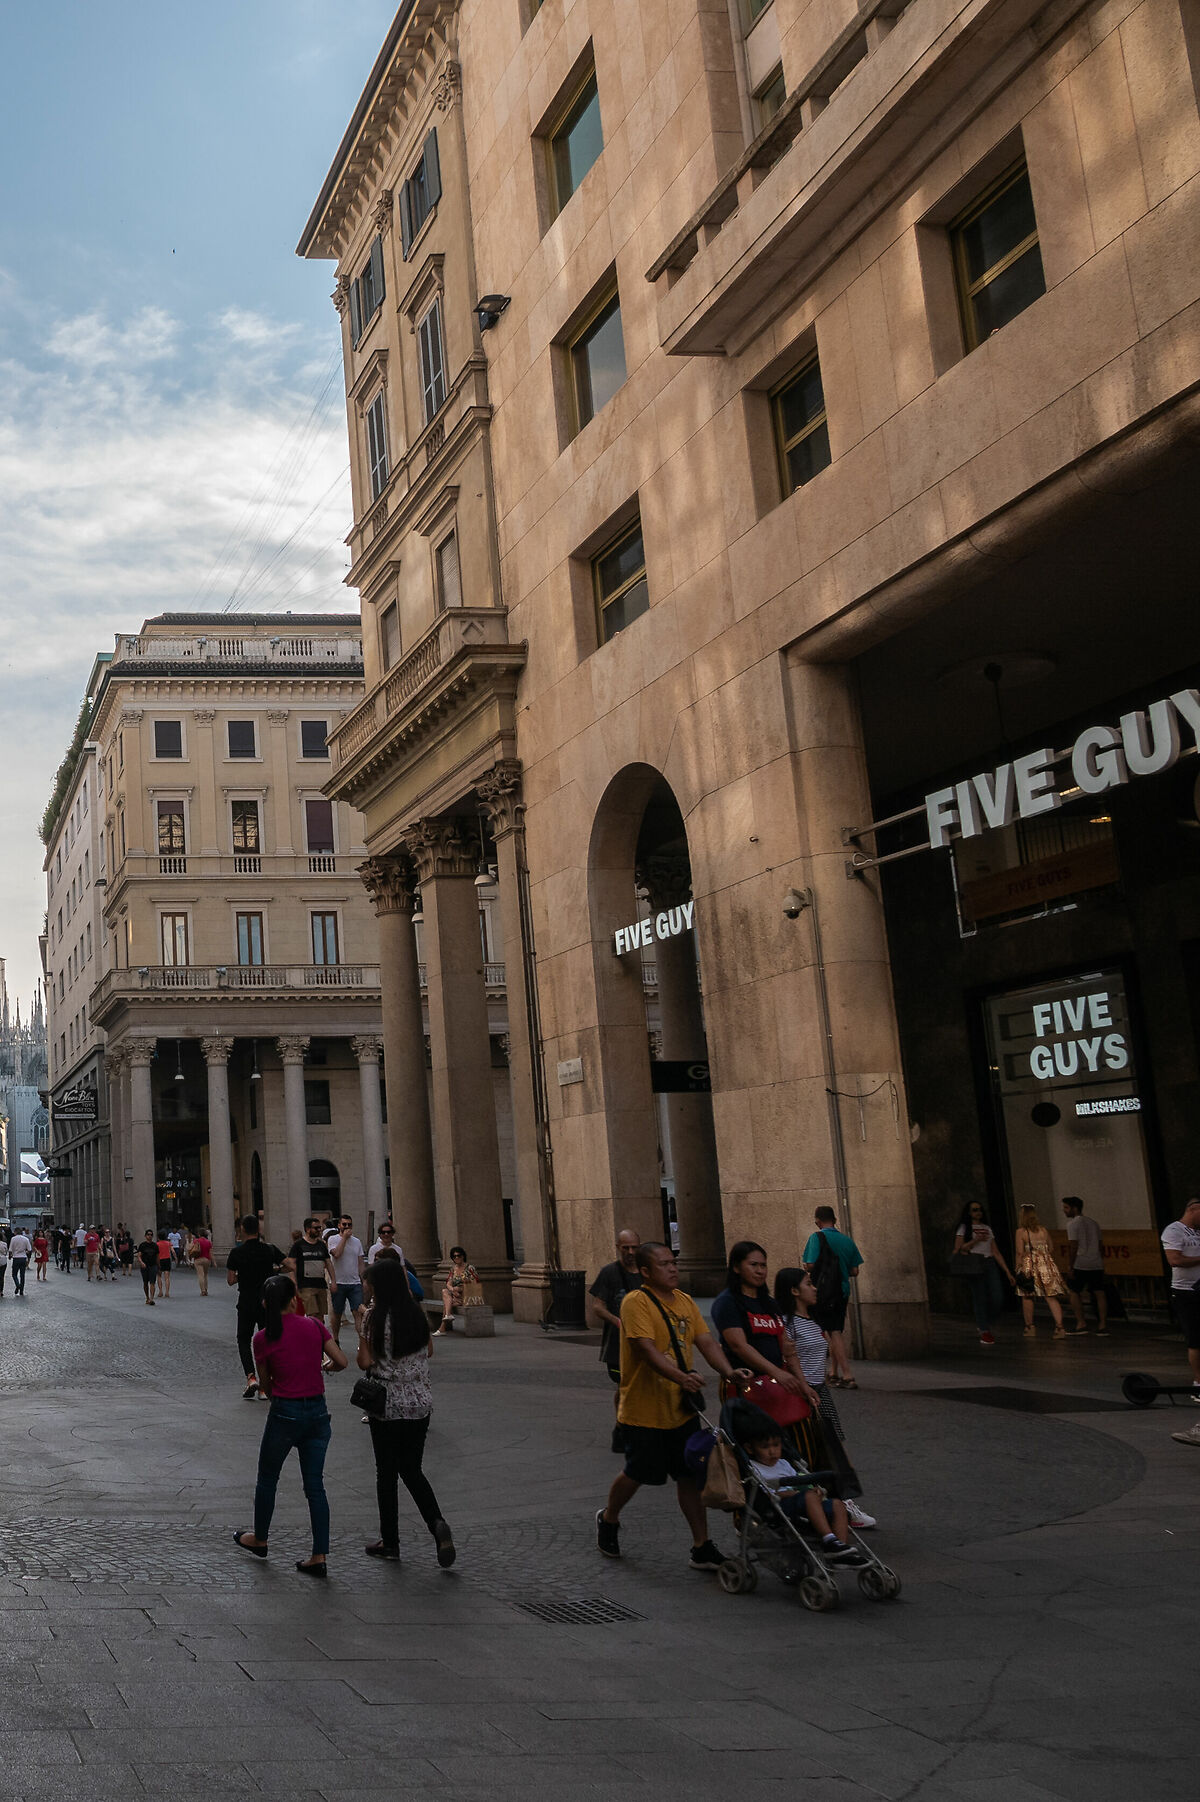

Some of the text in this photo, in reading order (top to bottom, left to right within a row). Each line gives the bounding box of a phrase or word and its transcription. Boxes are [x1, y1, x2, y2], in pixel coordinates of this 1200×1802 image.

[925, 748, 1061, 849] FIVE
[1008, 866, 1072, 896] FIVE GUYS
[614, 901, 694, 956] FIVE GUY
[1032, 992, 1113, 1038] FIVE
[1030, 1033, 1128, 1080] GUYS
[1075, 1098, 1141, 1116] MILKSHAKES
[1102, 1245, 1130, 1258] UYS
